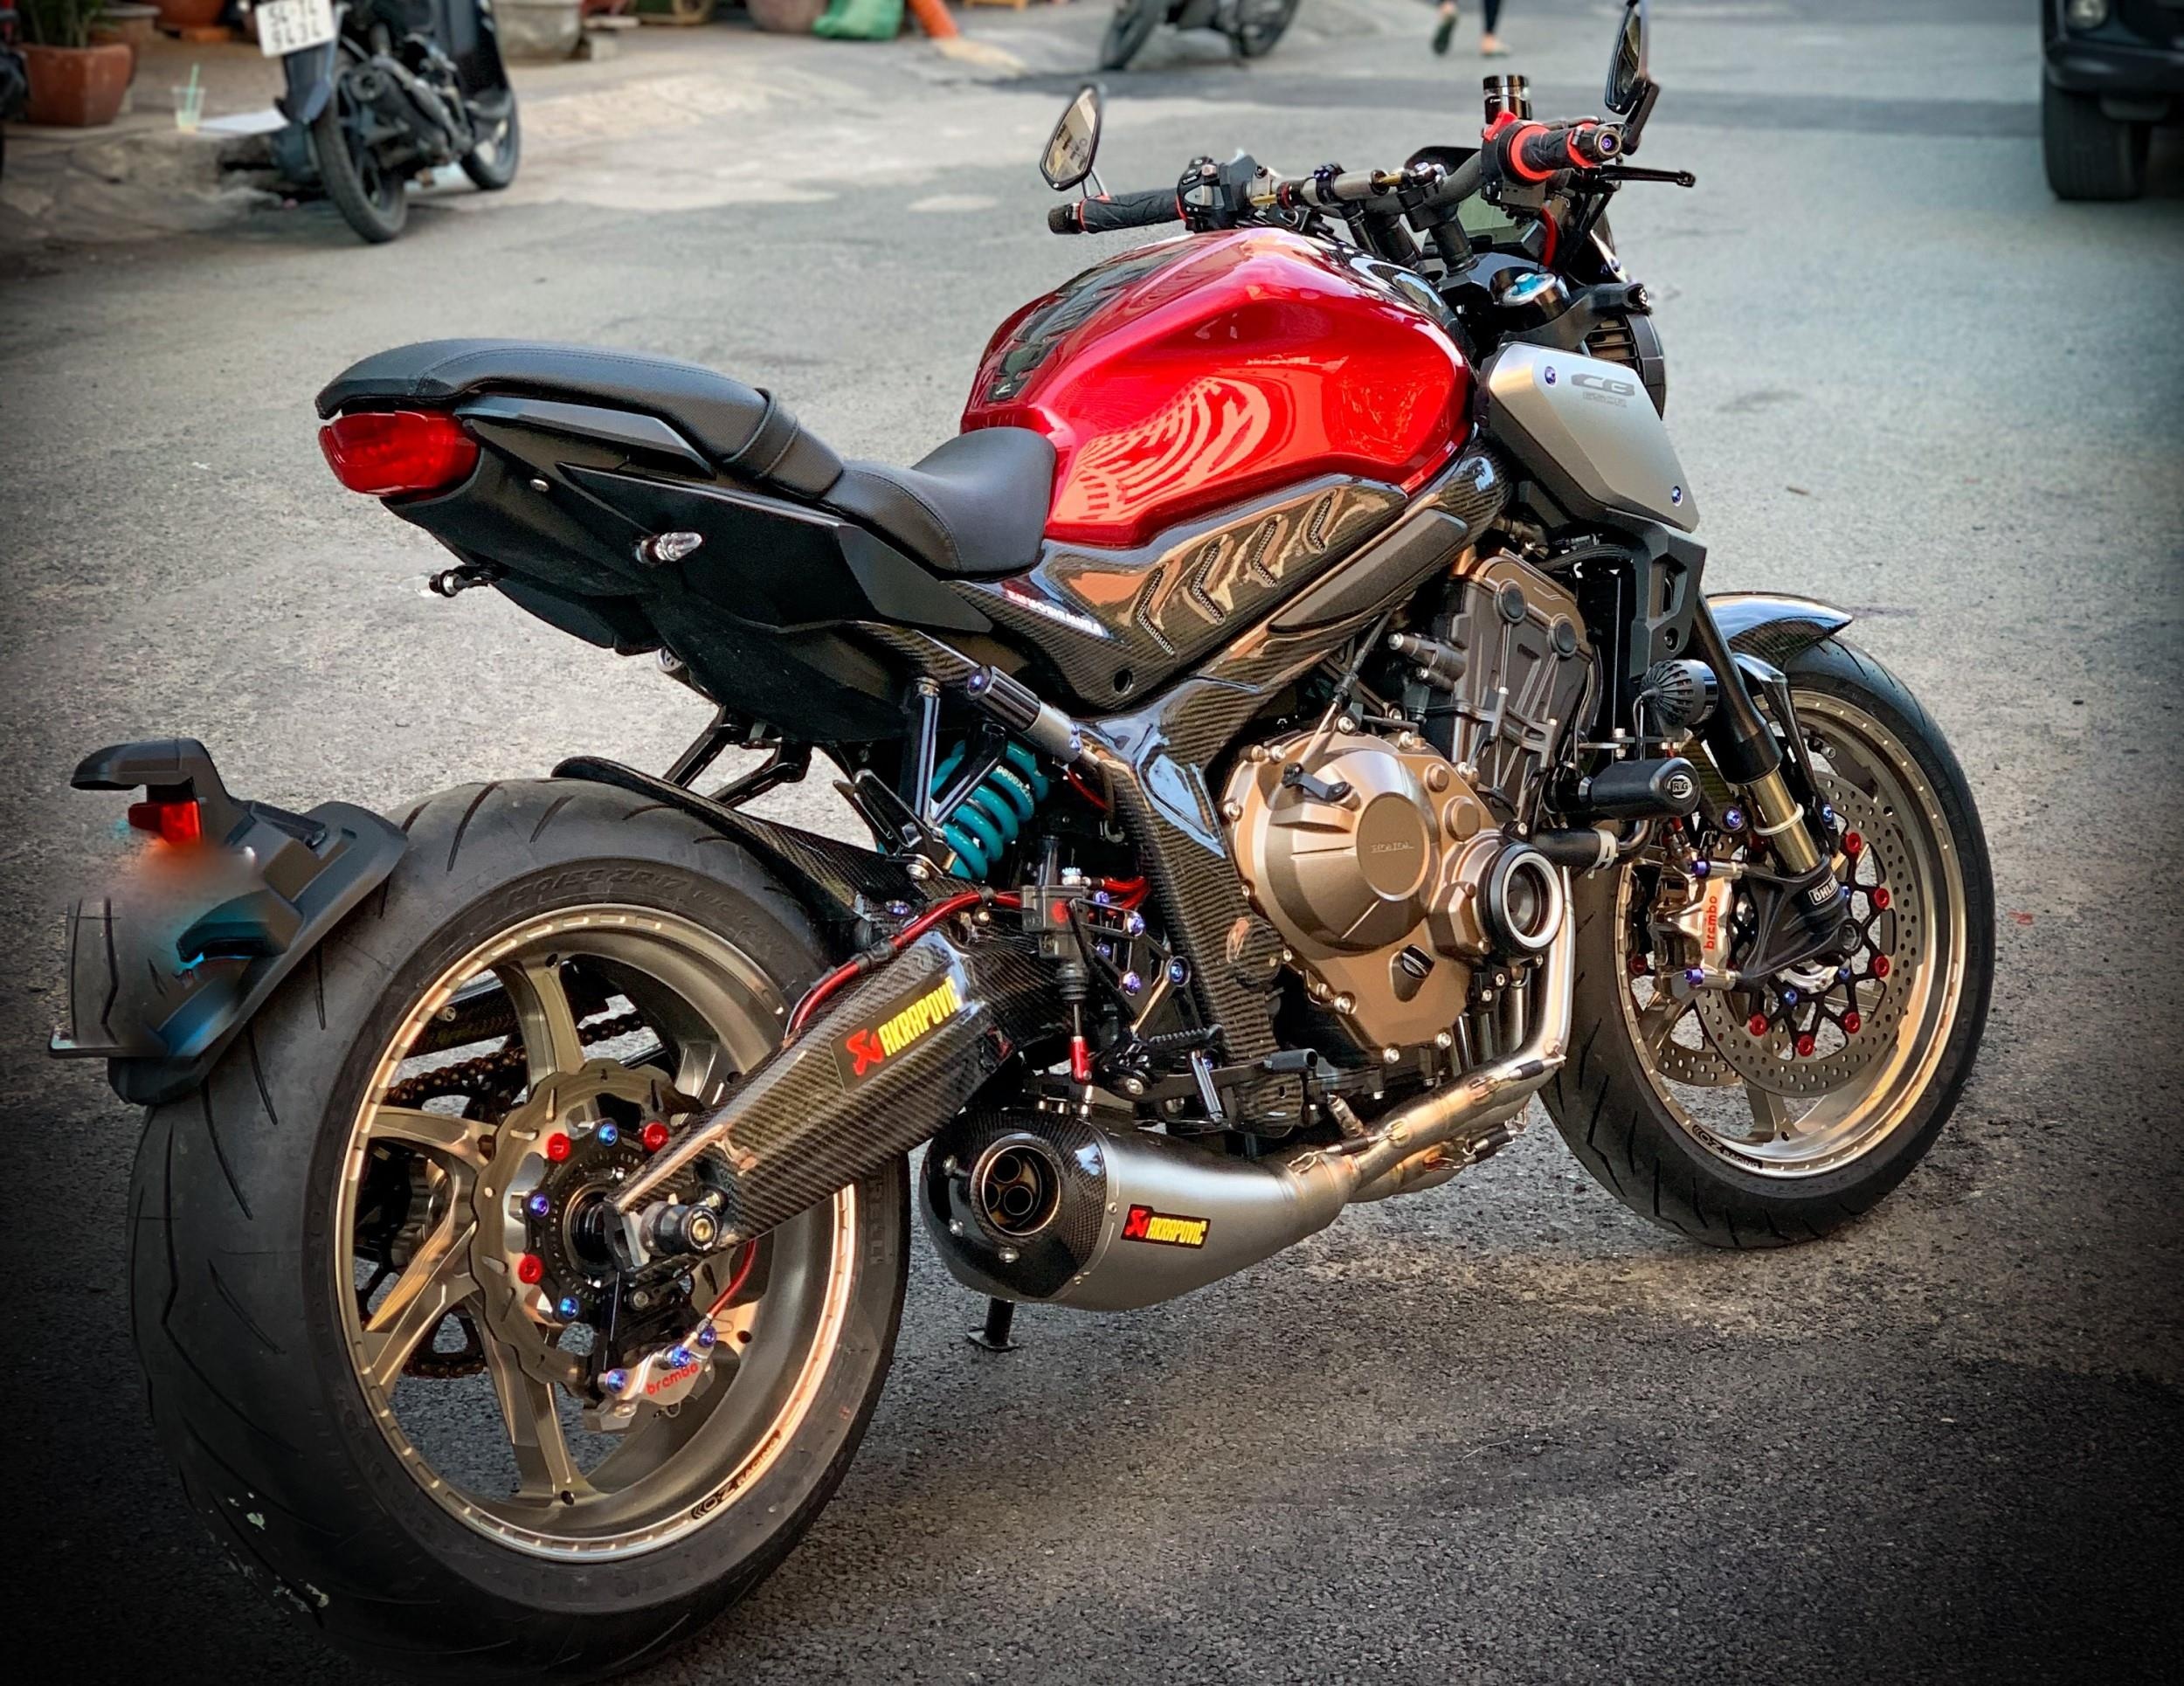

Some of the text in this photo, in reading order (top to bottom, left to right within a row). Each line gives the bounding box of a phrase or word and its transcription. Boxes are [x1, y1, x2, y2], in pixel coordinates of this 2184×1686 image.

[1571, 373, 1635, 396] CB
[1704, 895, 1718, 950] brembo
[646, 1362, 700, 1396] brembo
